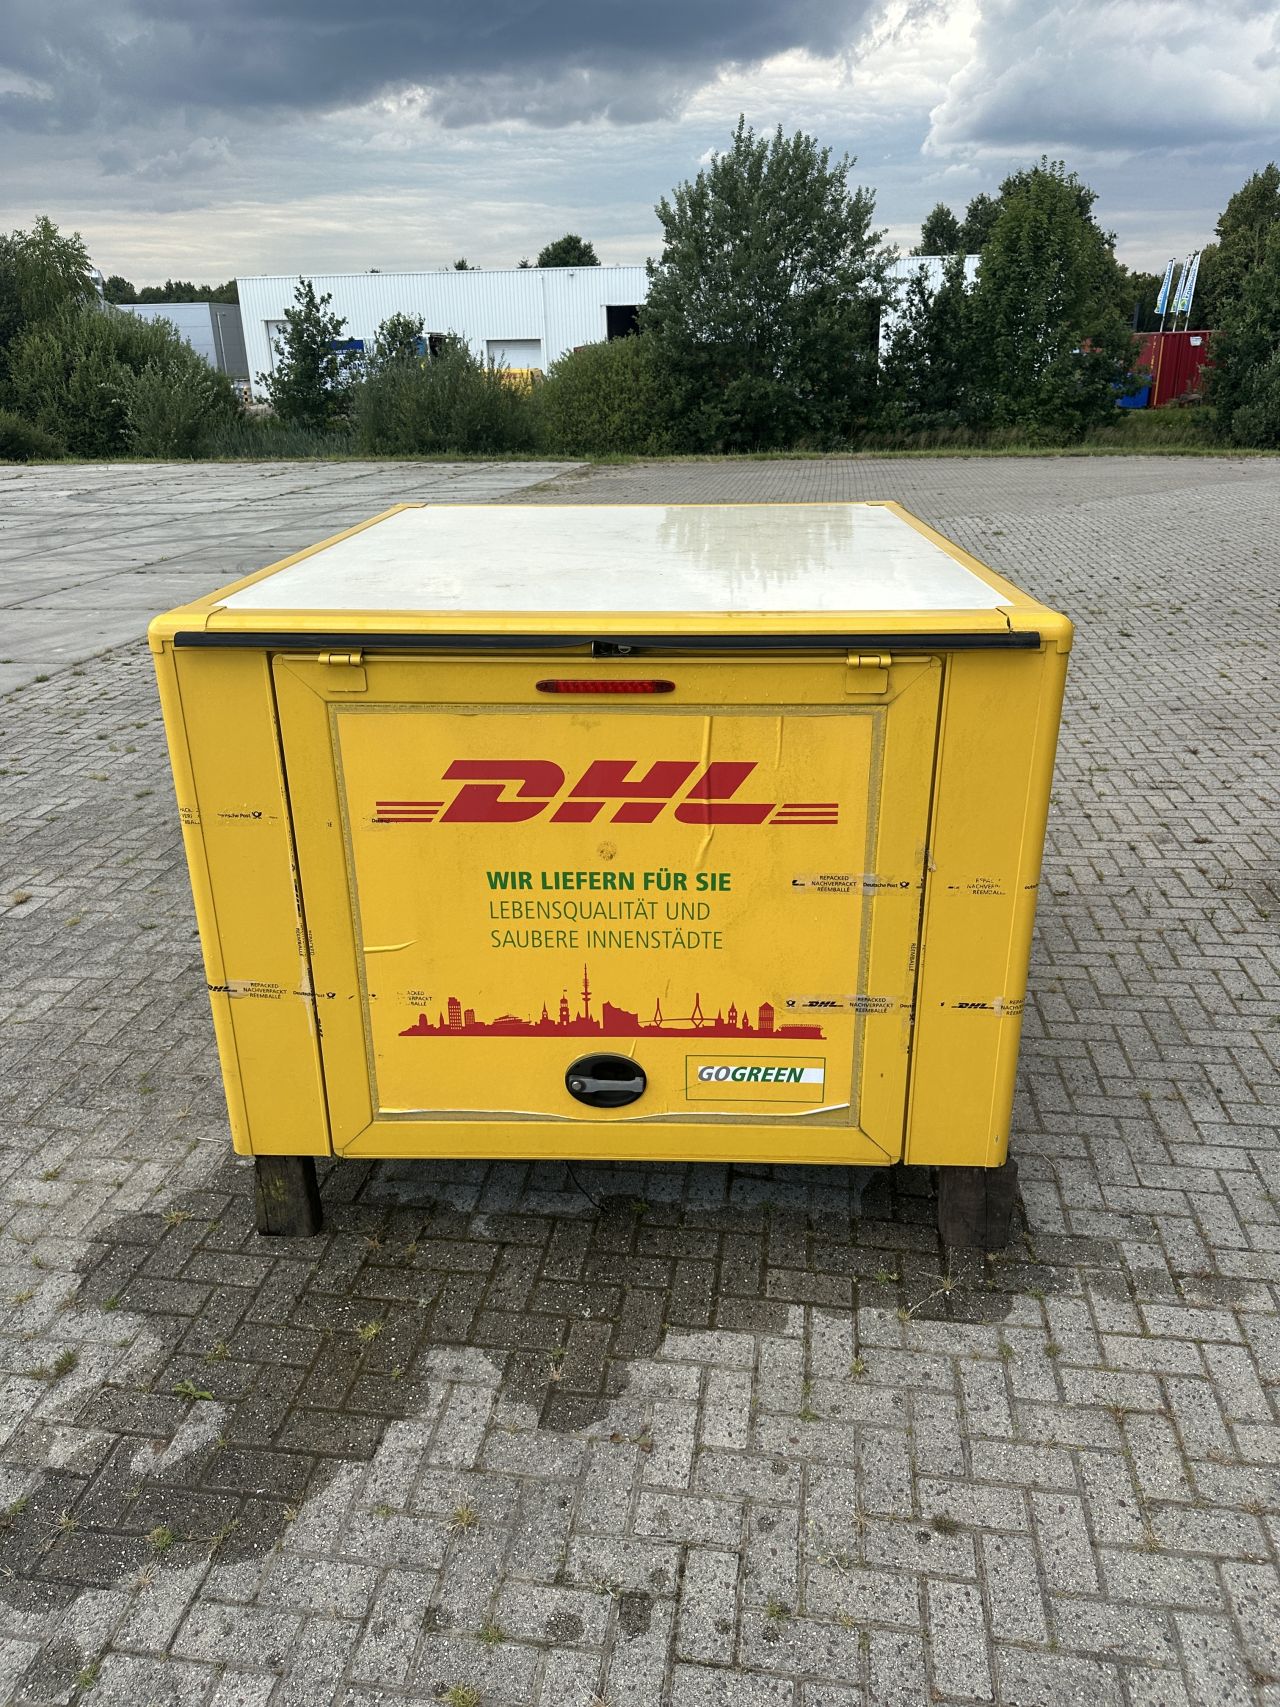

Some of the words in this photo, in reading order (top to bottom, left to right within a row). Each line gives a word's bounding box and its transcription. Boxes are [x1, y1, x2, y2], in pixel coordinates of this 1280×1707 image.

[439, 759, 777, 825] DHL
[486, 871, 533, 892] WIR
[540, 871, 635, 892] LIEFERN
[643, 867, 688, 892] FÜR
[695, 872, 732, 892] SIE
[489, 897, 658, 922] LEBENSQUALITÄT
[665, 901, 711, 921] UND
[491, 929, 579, 949] SAUBERE
[587, 926, 724, 950] INNENSTÄDTE
[243, 987, 288, 995] NACHVERPACKT
[806, 1000, 839, 1008] DHL
[698, 1065, 805, 1083] GOGREEN
